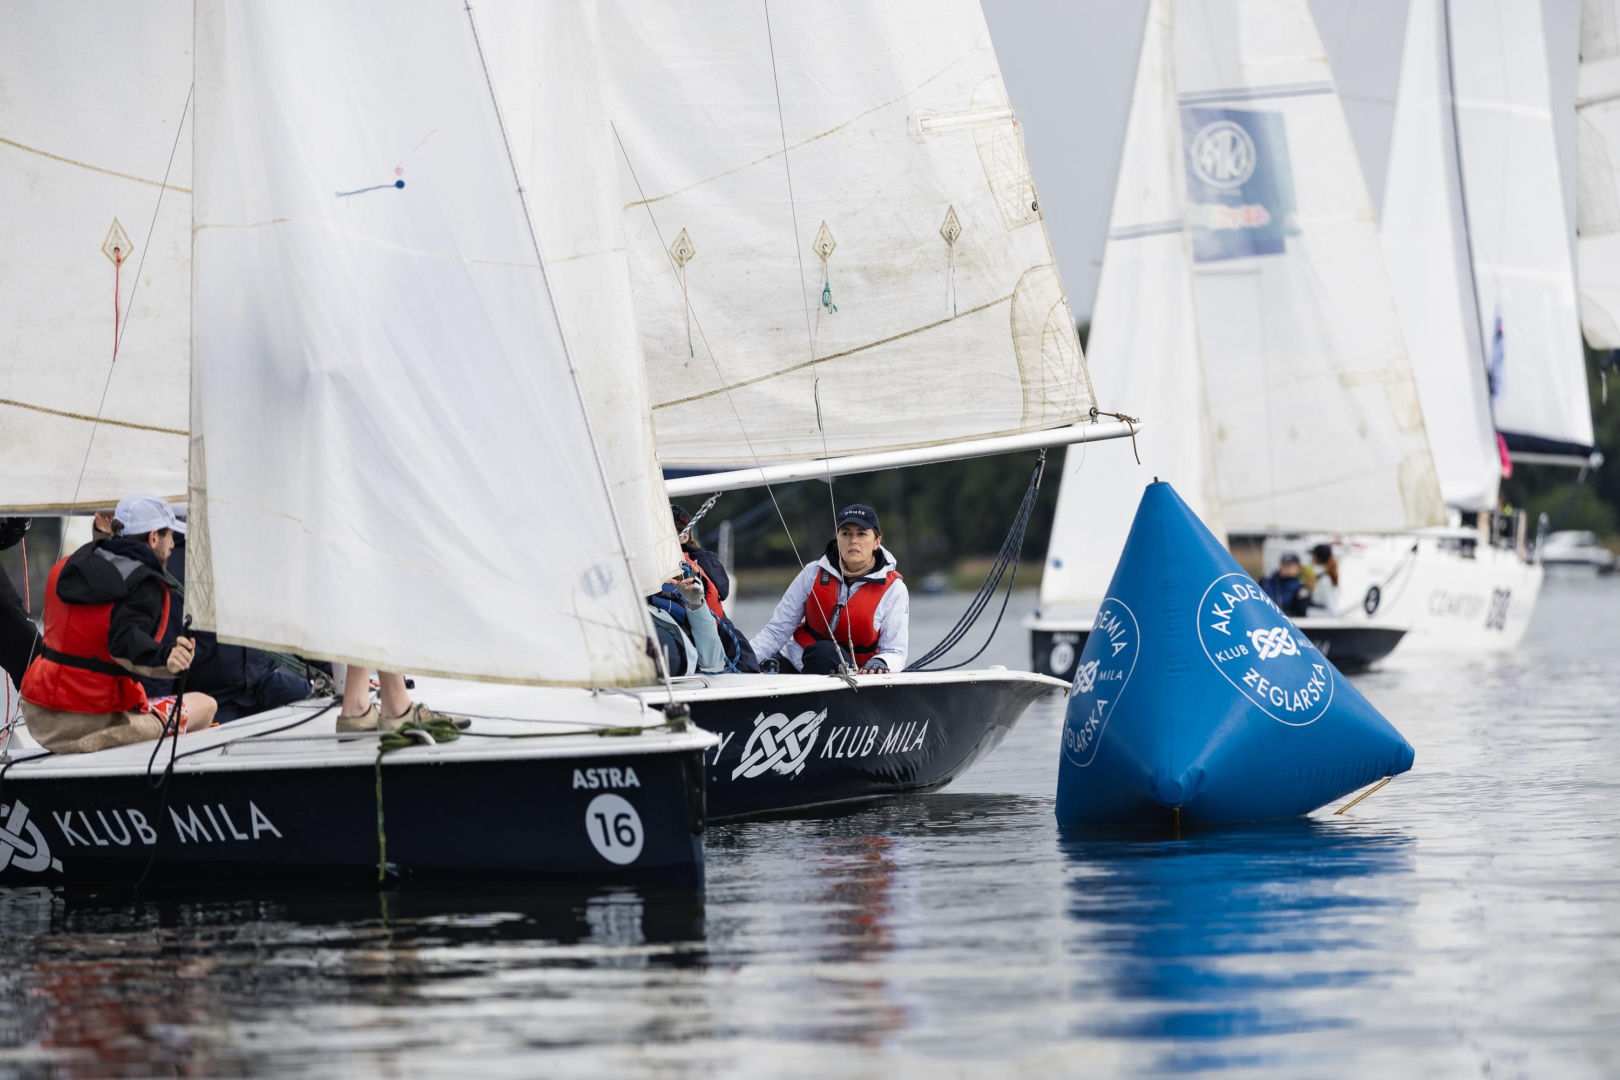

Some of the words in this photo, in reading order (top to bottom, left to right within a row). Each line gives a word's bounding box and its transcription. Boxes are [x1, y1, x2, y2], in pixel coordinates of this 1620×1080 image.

[1215, 644, 1249, 663] KLUB
[1098, 669, 1123, 681] MILA
[820, 725, 879, 759] KLUB
[878, 718, 930, 756] MILA
[573, 766, 641, 789] ASTRA
[52, 808, 158, 847] KLUB
[167, 800, 283, 843] MILA
[594, 812, 636, 848] 16
